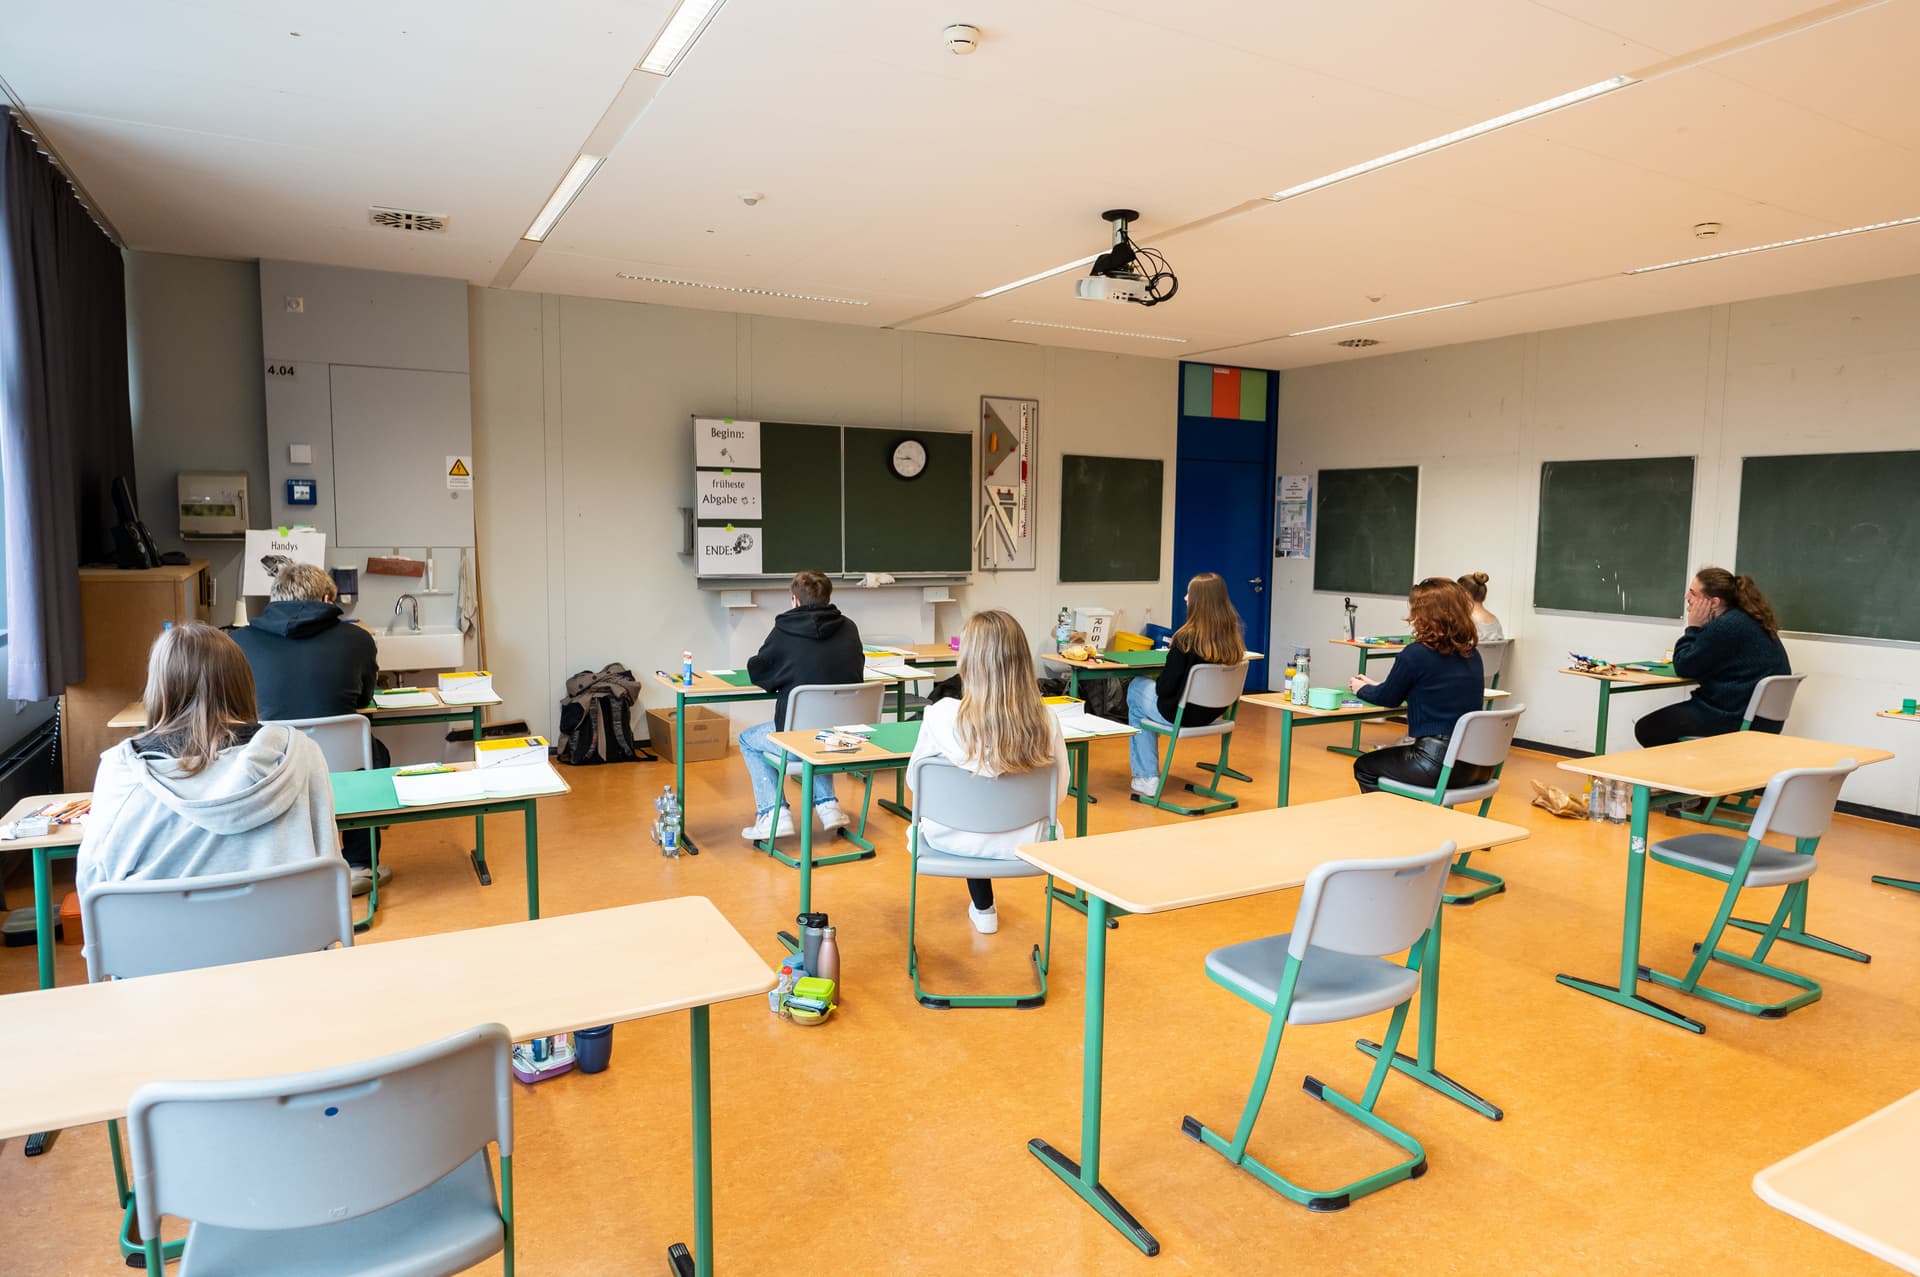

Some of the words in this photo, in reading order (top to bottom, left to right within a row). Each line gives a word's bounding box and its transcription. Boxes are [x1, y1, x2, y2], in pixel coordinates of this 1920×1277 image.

[267, 364, 295, 376] 4.04
[711, 427, 745, 440] Beginn:
[712, 479, 746, 489] früheste
[702, 494, 738, 506] Abgabe
[271, 541, 298, 553] Handys
[705, 545, 733, 556] ENDE:
